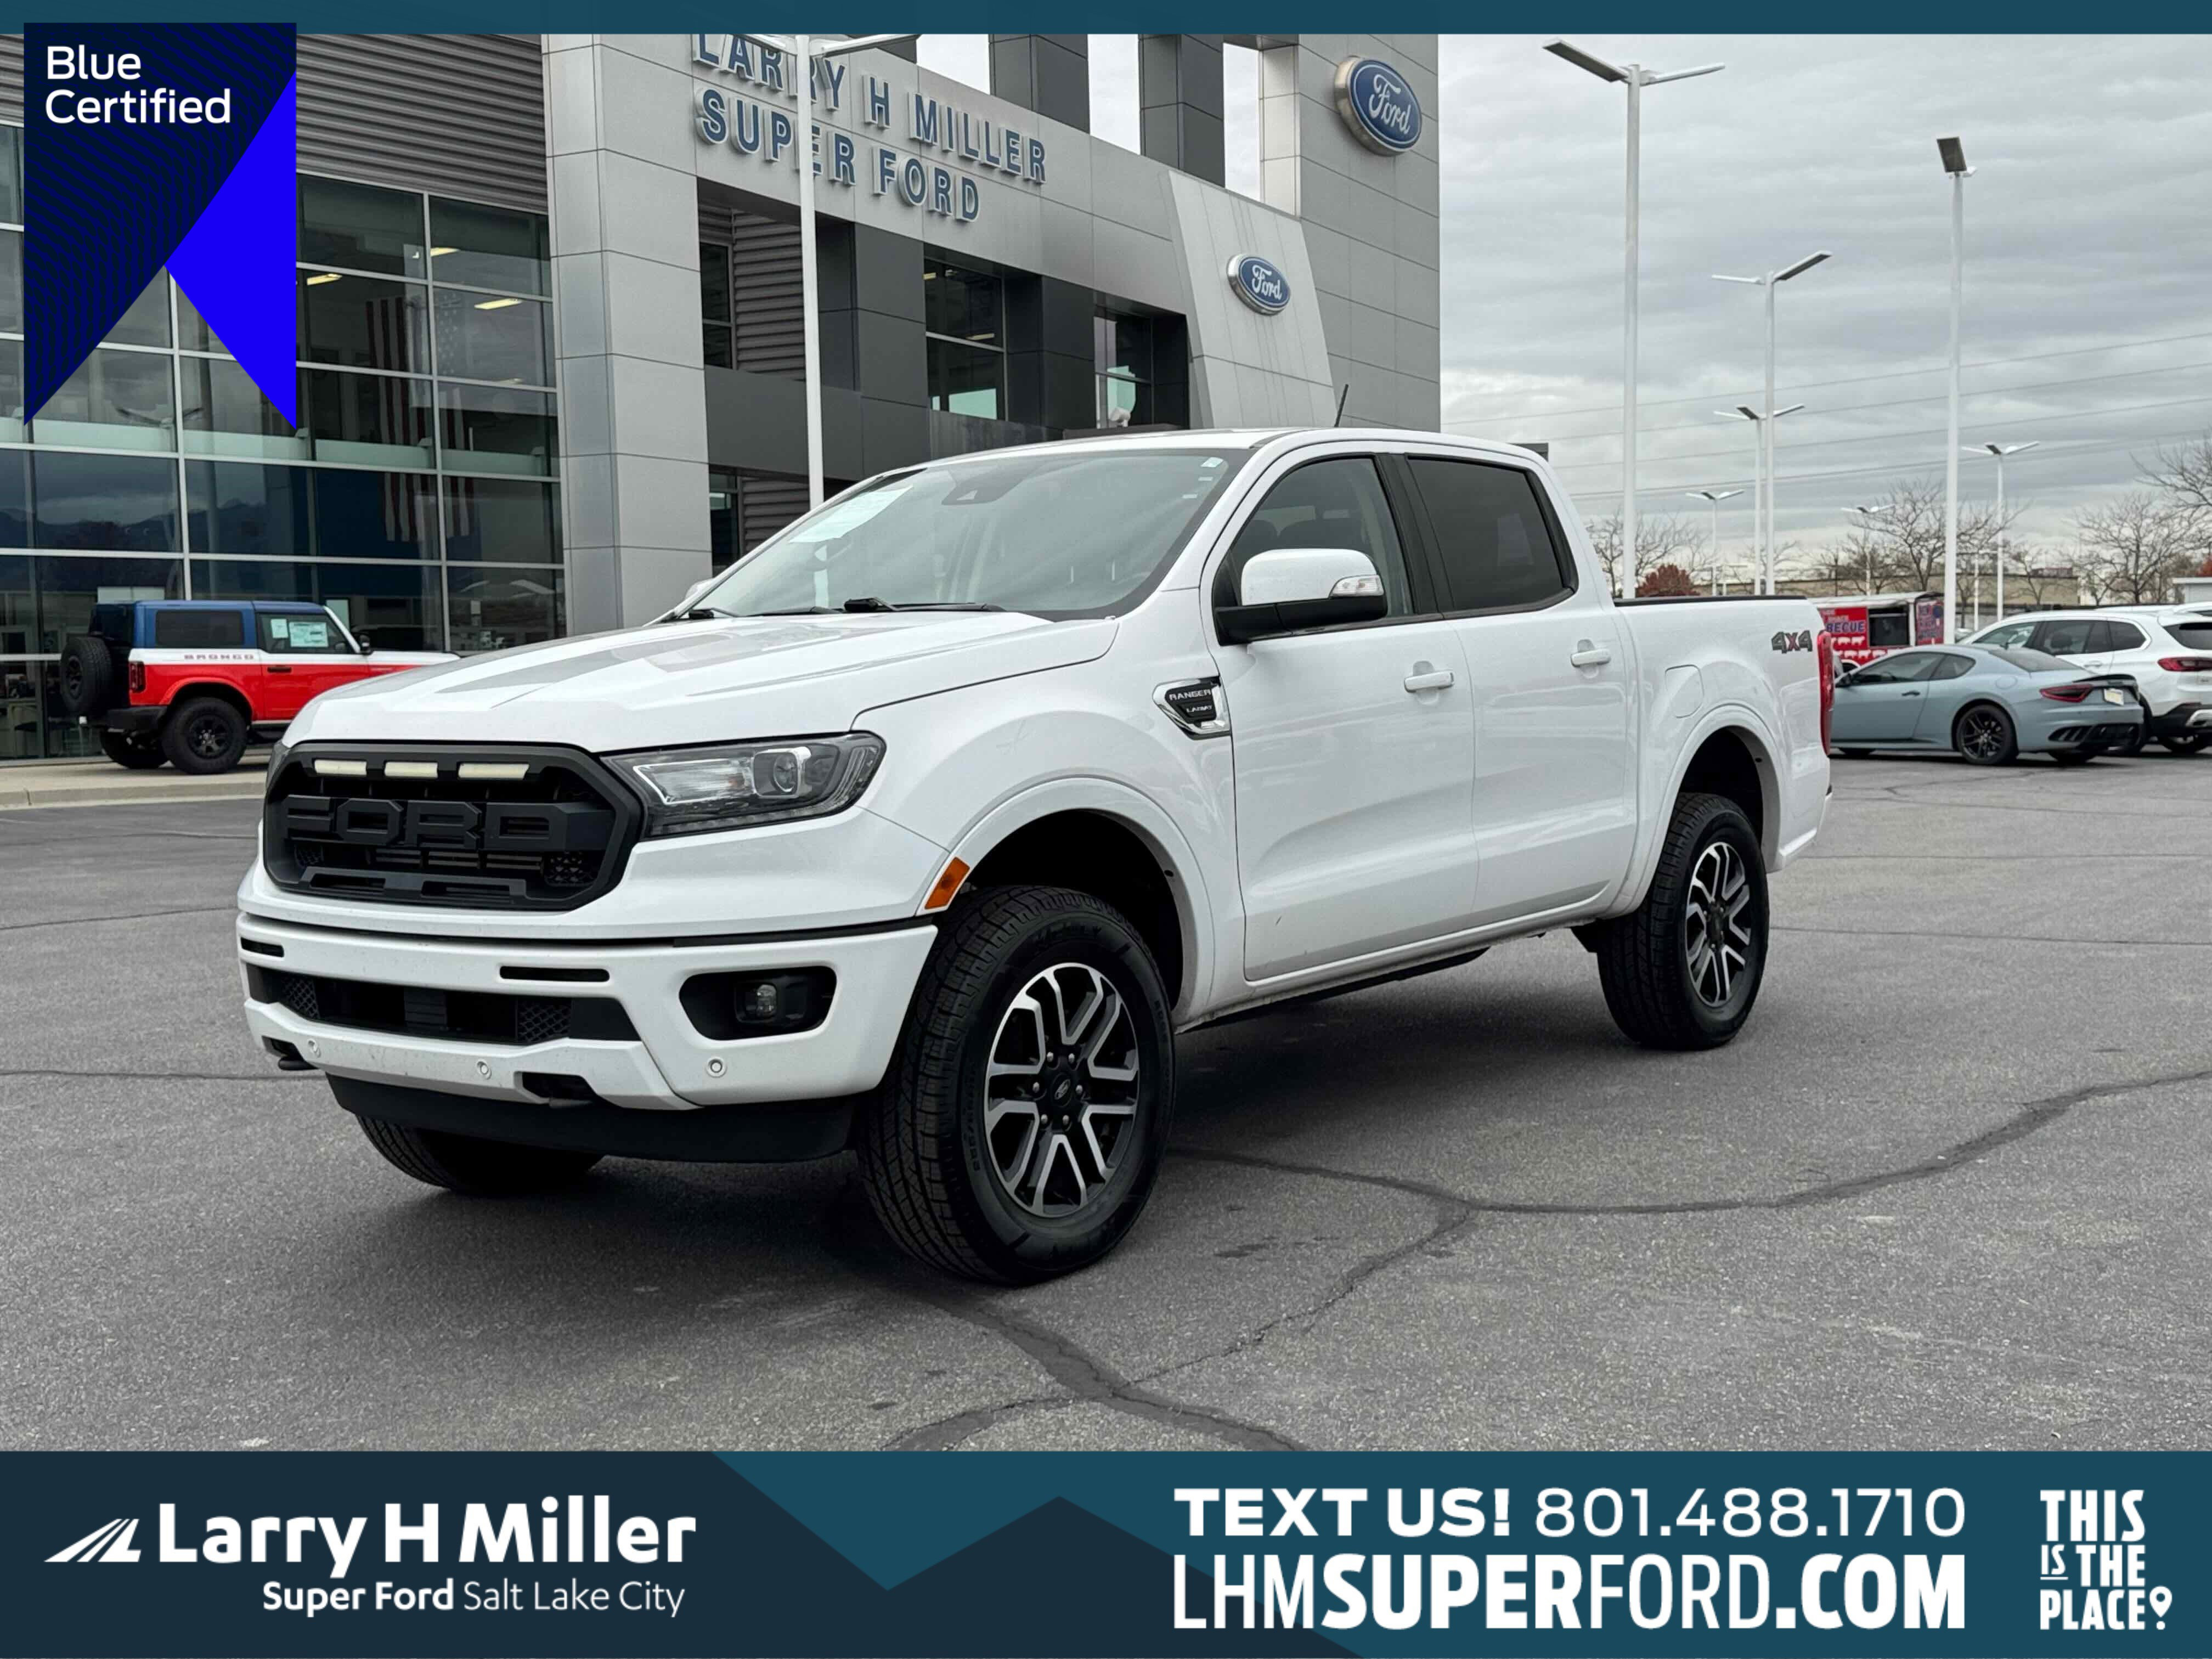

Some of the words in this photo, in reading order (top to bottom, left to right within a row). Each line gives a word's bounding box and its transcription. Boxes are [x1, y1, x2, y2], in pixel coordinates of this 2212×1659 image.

[867, 74, 891, 129] H
[911, 92, 1047, 185] MILLER
[1368, 74, 1410, 134] Ford
[699, 87, 857, 187] SUPER
[876, 145, 981, 222] FORD
[1251, 264, 1283, 300] Ford
[1169, 689, 1211, 701] RANGER
[277, 794, 567, 852] FORD
